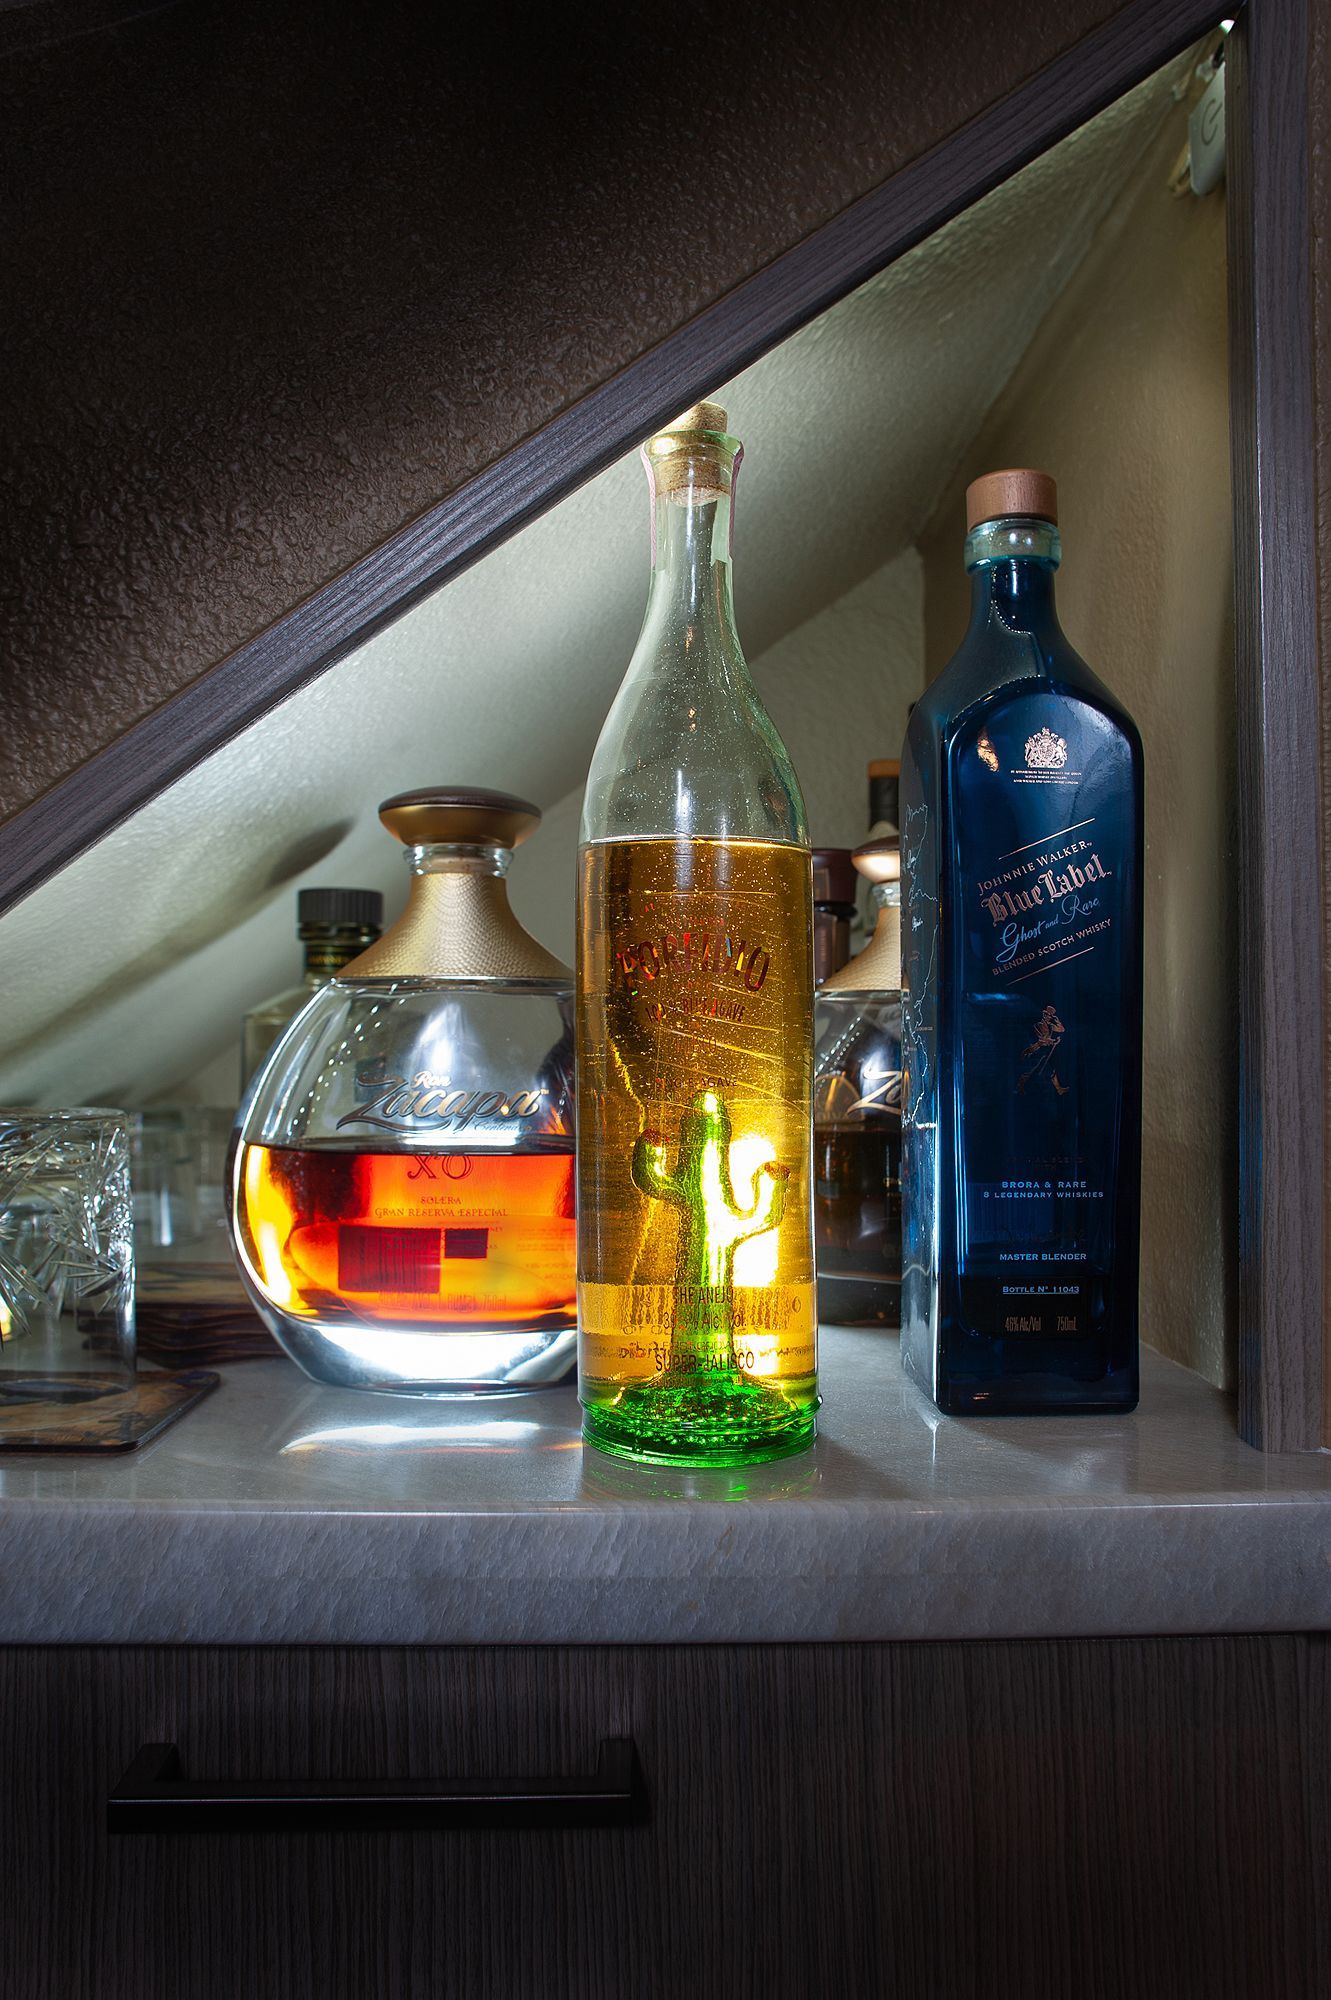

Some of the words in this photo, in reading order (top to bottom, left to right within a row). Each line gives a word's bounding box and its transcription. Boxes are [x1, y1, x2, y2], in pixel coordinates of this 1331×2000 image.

[978, 862, 1036, 895] JOHNNIE
[1036, 841, 1088, 868] WALKER
[981, 884, 1044, 927] Blue
[1038, 853, 1107, 902] Label
[995, 920, 1044, 962] Ghost
[1045, 914, 1059, 929] and
[1061, 894, 1100, 925] Rare
[992, 952, 1035, 976] BLENDED
[1038, 935, 1075, 957] SCOTCH
[1076, 918, 1112, 940] WHISKY
[411, 1071, 451, 1088] Ron
[336, 1072, 542, 1135] Zacapa
[1001, 1181, 1040, 1189] BRORA
[1044, 1181, 1051, 1189] &
[1058, 1181, 1087, 1189] RARE
[420, 1196, 462, 1205] SOLERA
[983, 1191, 990, 1199] 8
[994, 1191, 1052, 1199] LEGENDARY
[1056, 1191, 1104, 1199] WHISKIES
[375, 1208, 404, 1219] GRAN
[408, 1208, 454, 1217] RESERVA
[458, 1208, 509, 1217] ESPECIAL
[1000, 1253, 1039, 1261] MASTER
[1041, 1253, 1087, 1261] BLENDER
[655, 1351, 755, 1372] SUPER-JALISCO
